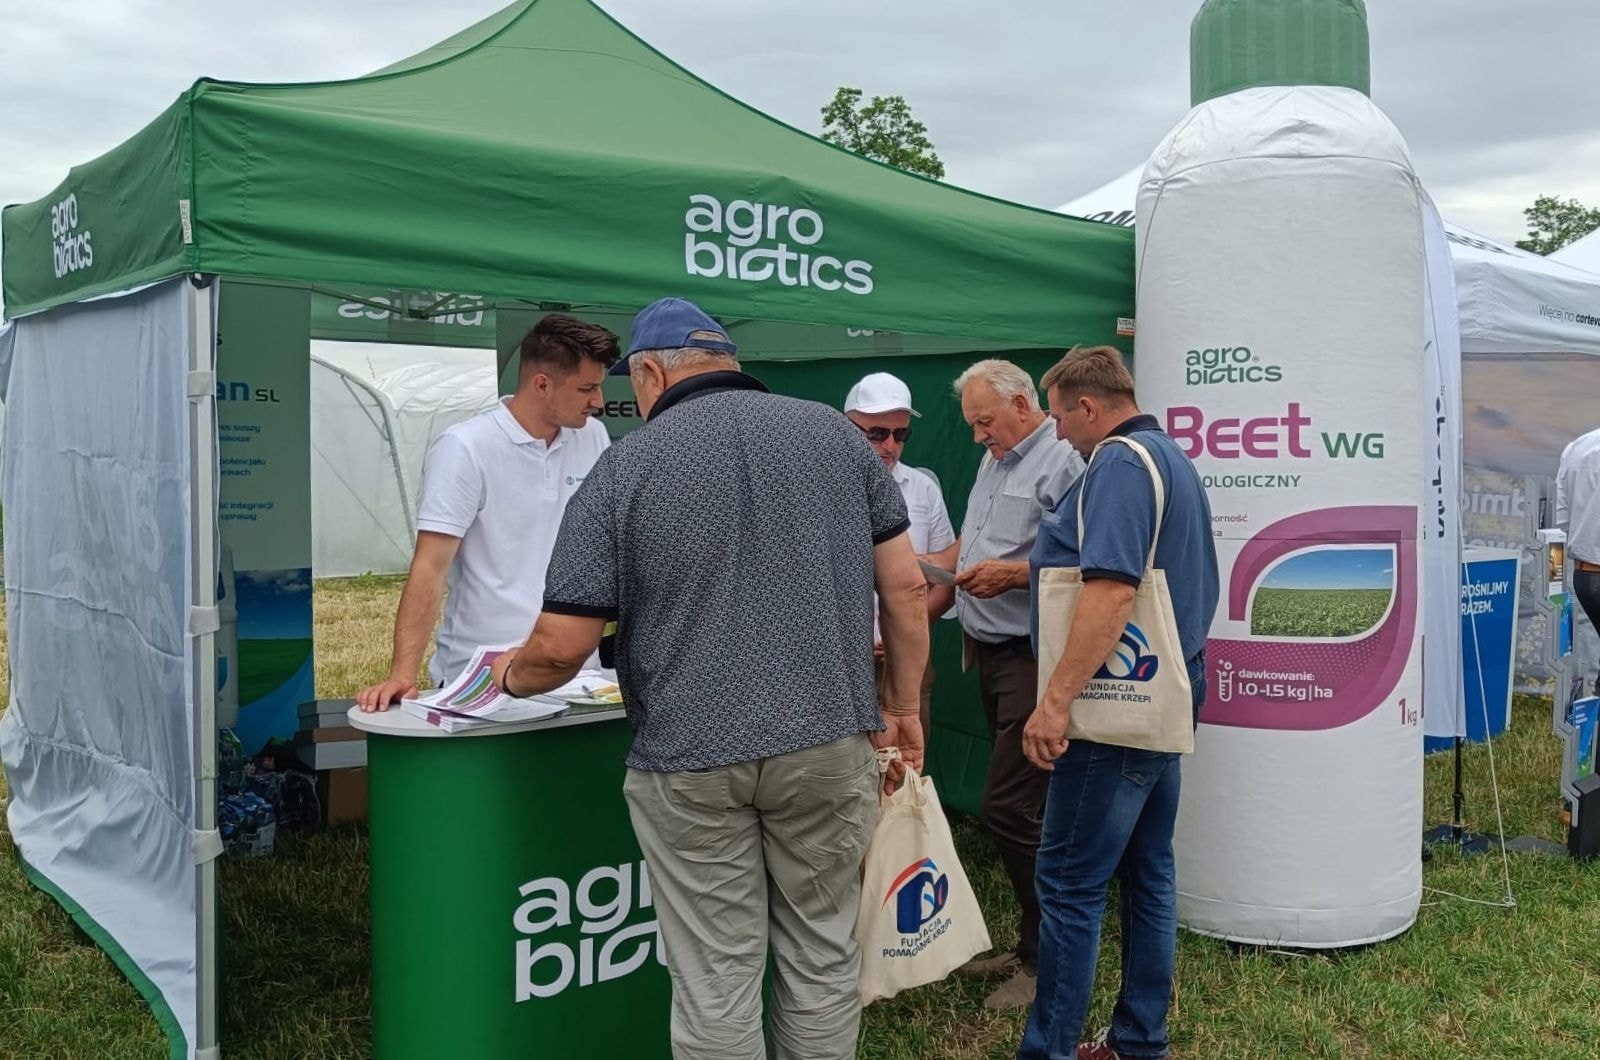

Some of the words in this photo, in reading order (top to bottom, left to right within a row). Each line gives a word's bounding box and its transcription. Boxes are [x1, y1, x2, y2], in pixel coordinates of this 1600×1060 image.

[51, 193, 78, 244] agro
[685, 194, 824, 247] agro
[53, 231, 93, 278] biotics
[685, 232, 874, 295] biotics
[1186, 346, 1251, 369] agro
[1186, 364, 1283, 386] biotics
[255, 390, 280, 403] SL
[1321, 432, 1385, 459] WG
[1202, 475, 1302, 489] OLOGICZNY
[1238, 668, 1315, 681] dawkowanie:
[1084, 682, 1136, 693] FUNDACJA
[1120, 693, 1152, 703] KRZEPI
[1398, 698, 1406, 726] 1
[1407, 709, 1417, 726] kg
